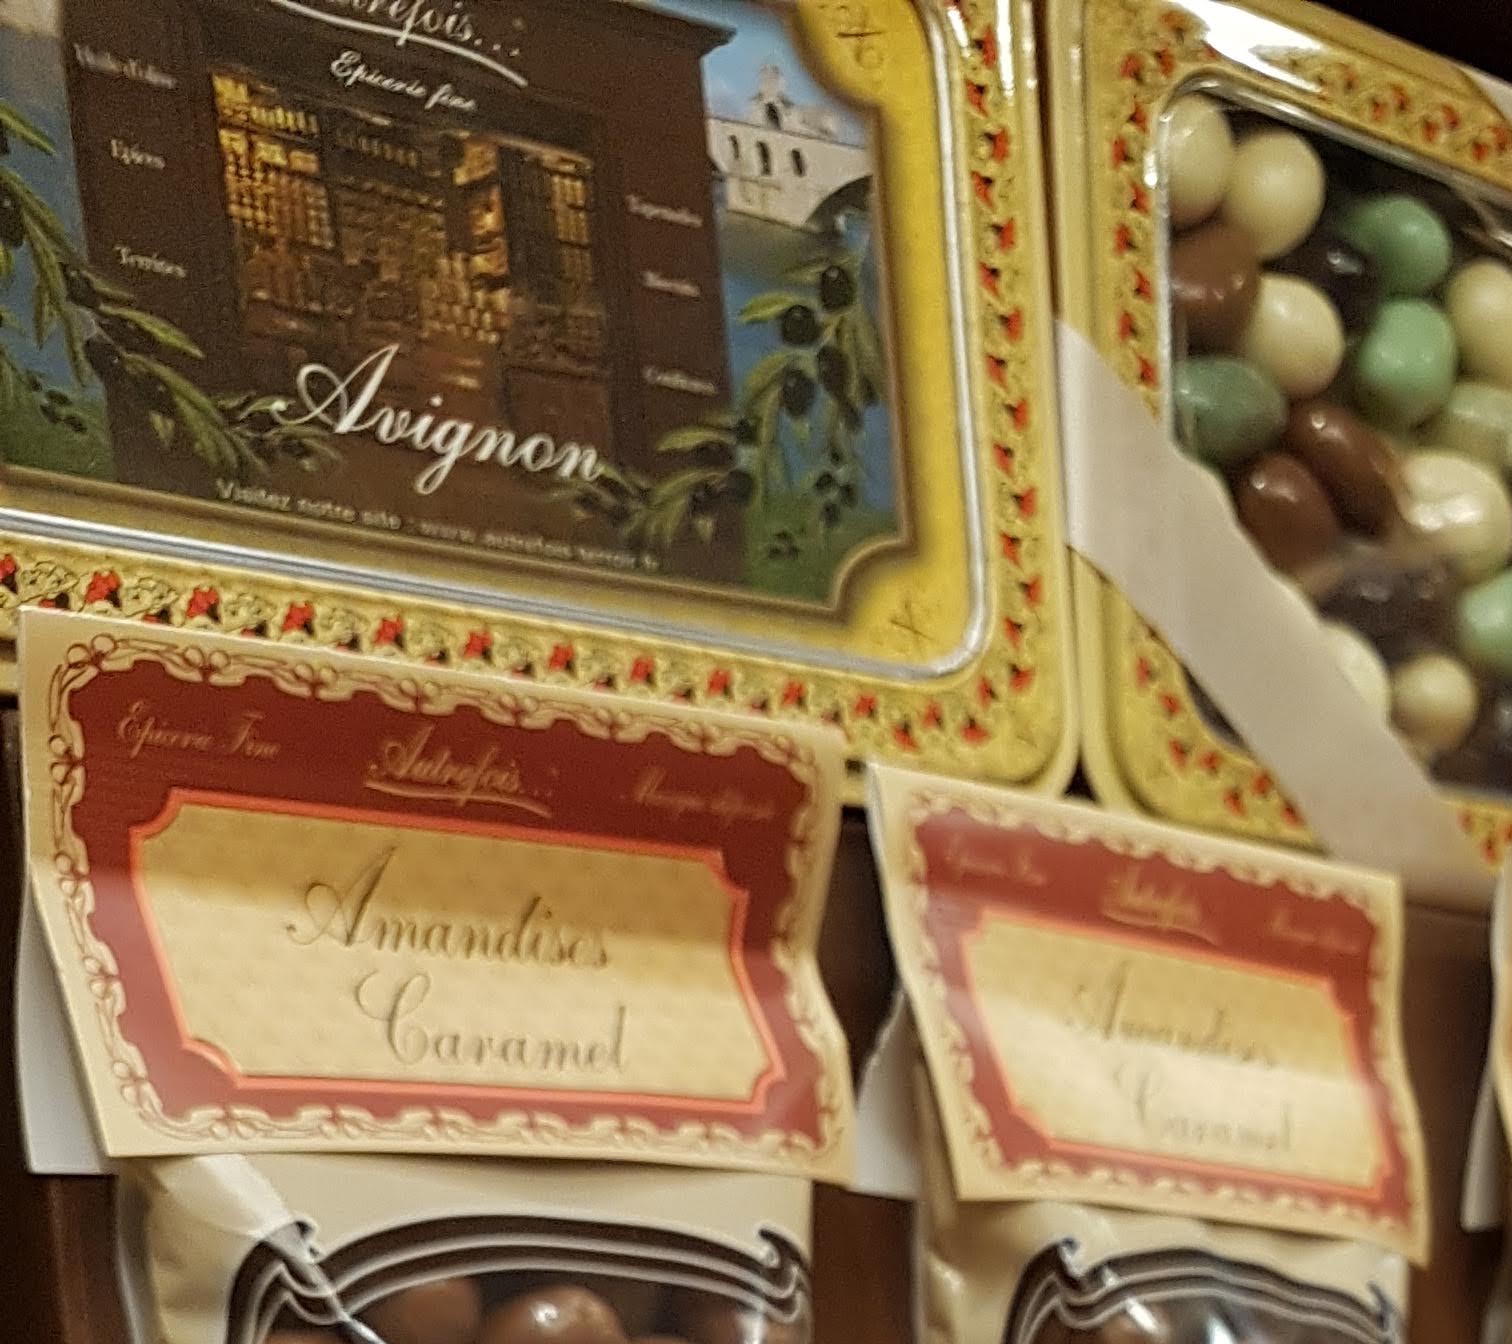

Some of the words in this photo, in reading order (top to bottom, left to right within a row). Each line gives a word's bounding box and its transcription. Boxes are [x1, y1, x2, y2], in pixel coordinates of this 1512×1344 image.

[268, 342, 604, 495] Avignon
[215, 477, 291, 512] Visitez
[297, 499, 357, 523] notre
[362, 511, 401, 531] site
[353, 968, 628, 1073] Caramel
